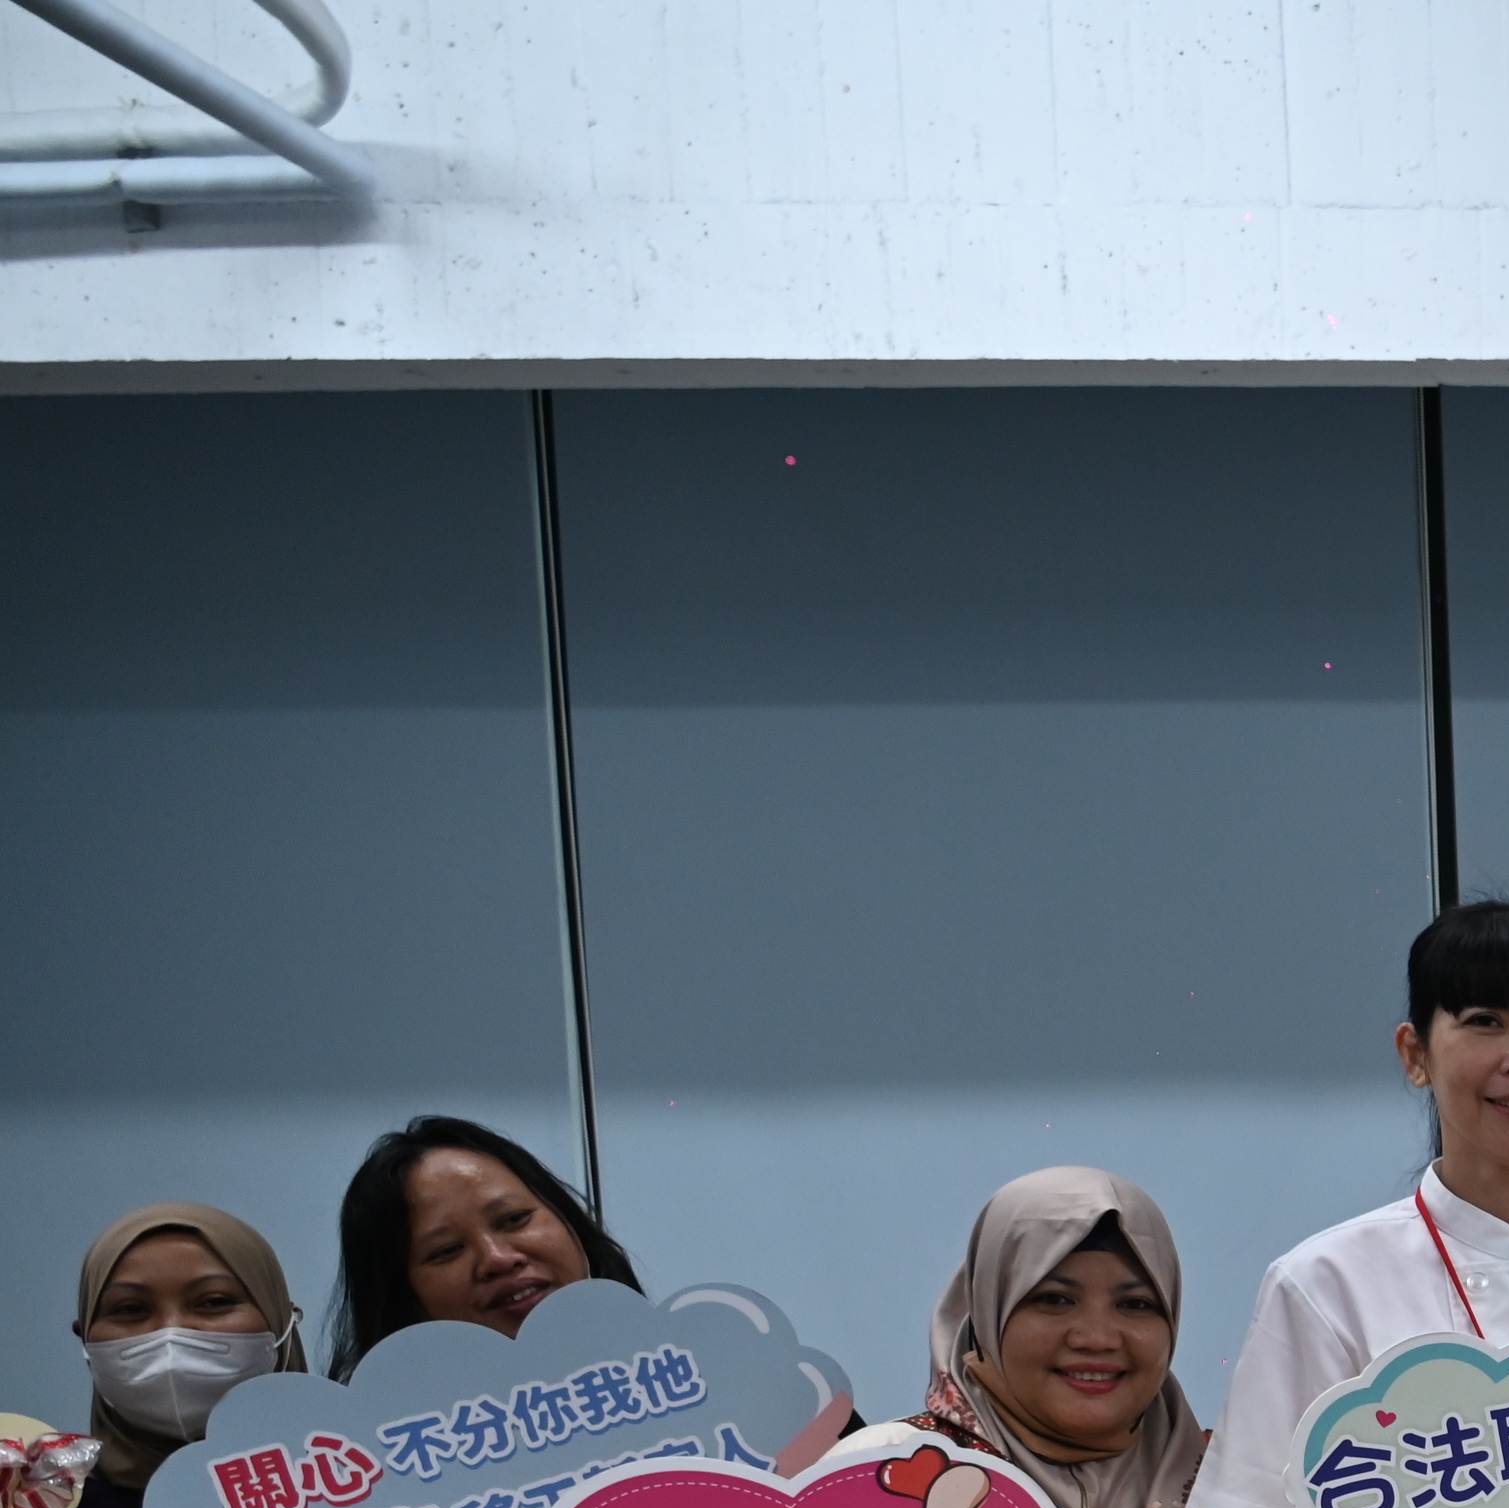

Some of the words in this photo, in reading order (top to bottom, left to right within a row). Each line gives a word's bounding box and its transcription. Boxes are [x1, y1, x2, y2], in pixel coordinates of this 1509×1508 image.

[380, 1347, 707, 1480] 不分你我他
